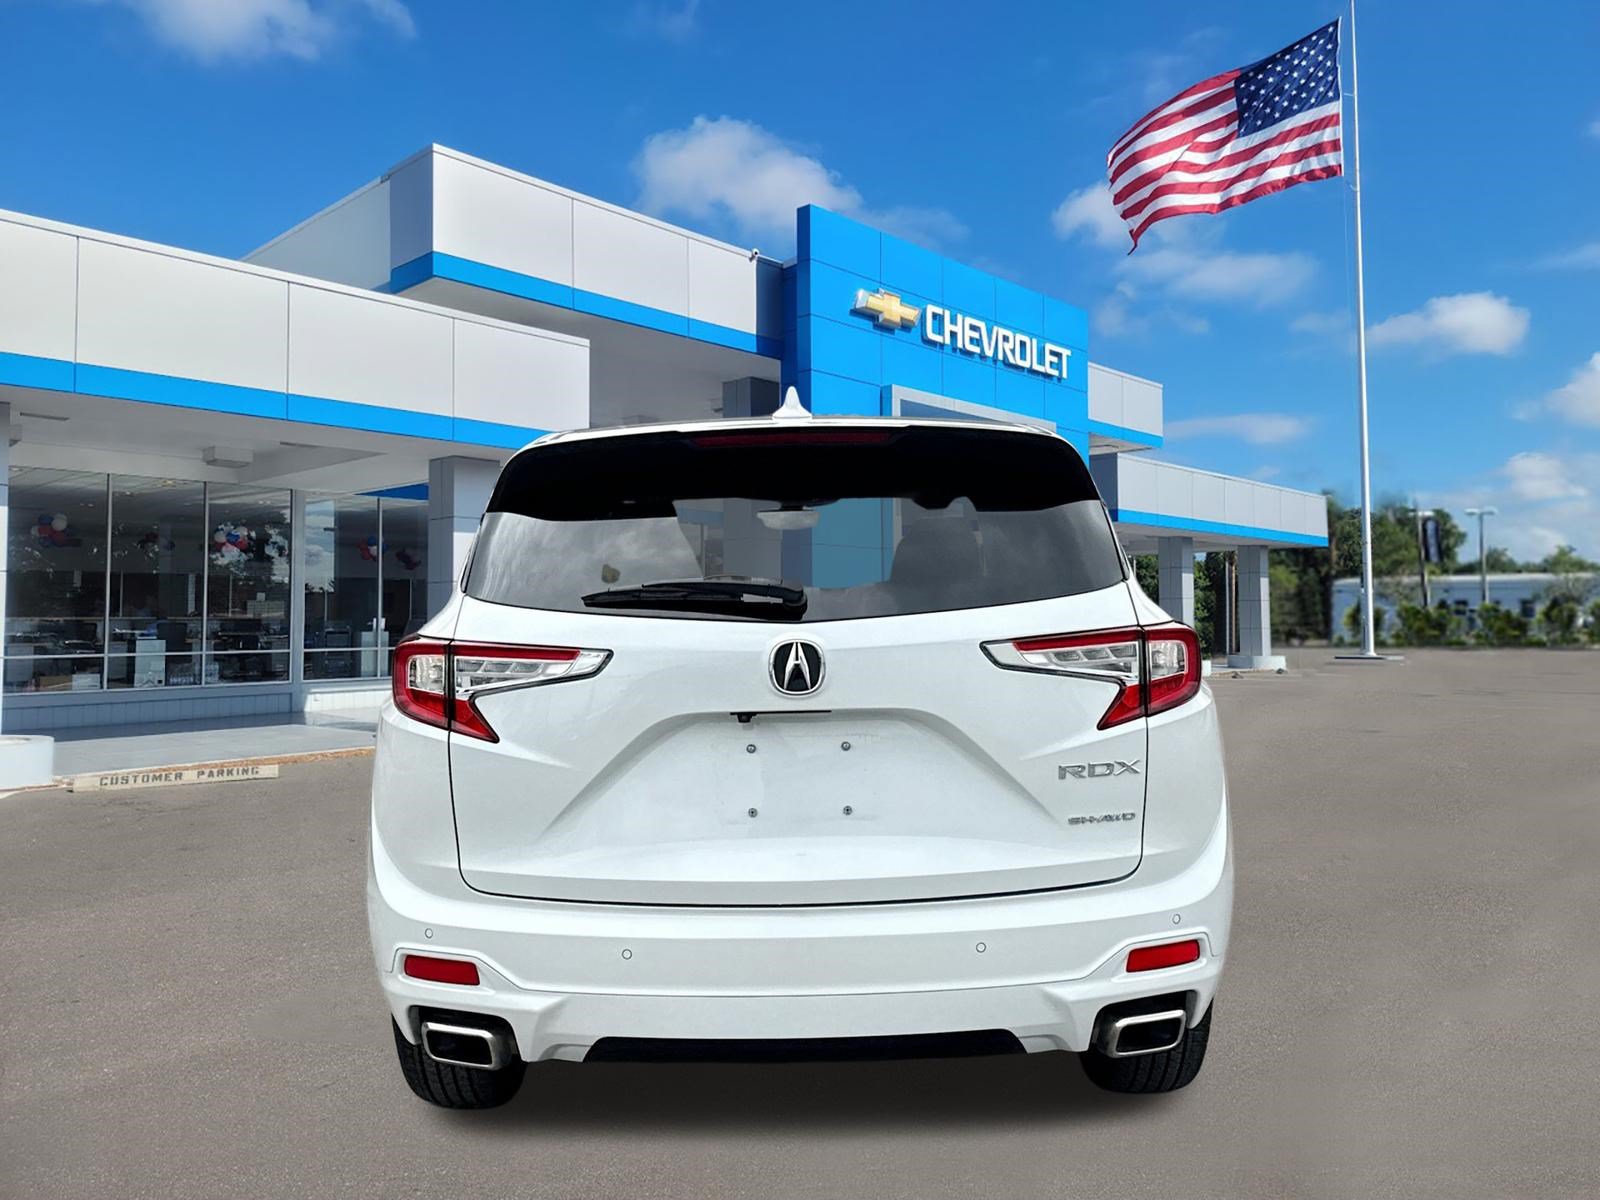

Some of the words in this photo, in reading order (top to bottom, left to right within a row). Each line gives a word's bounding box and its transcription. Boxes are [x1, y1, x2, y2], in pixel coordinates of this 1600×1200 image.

[925, 303, 1072, 380] CHEVROLET
[99, 771, 184, 787] CUSTOMER
[197, 765, 260, 780] PARKING
[1058, 759, 1140, 780] RDX
